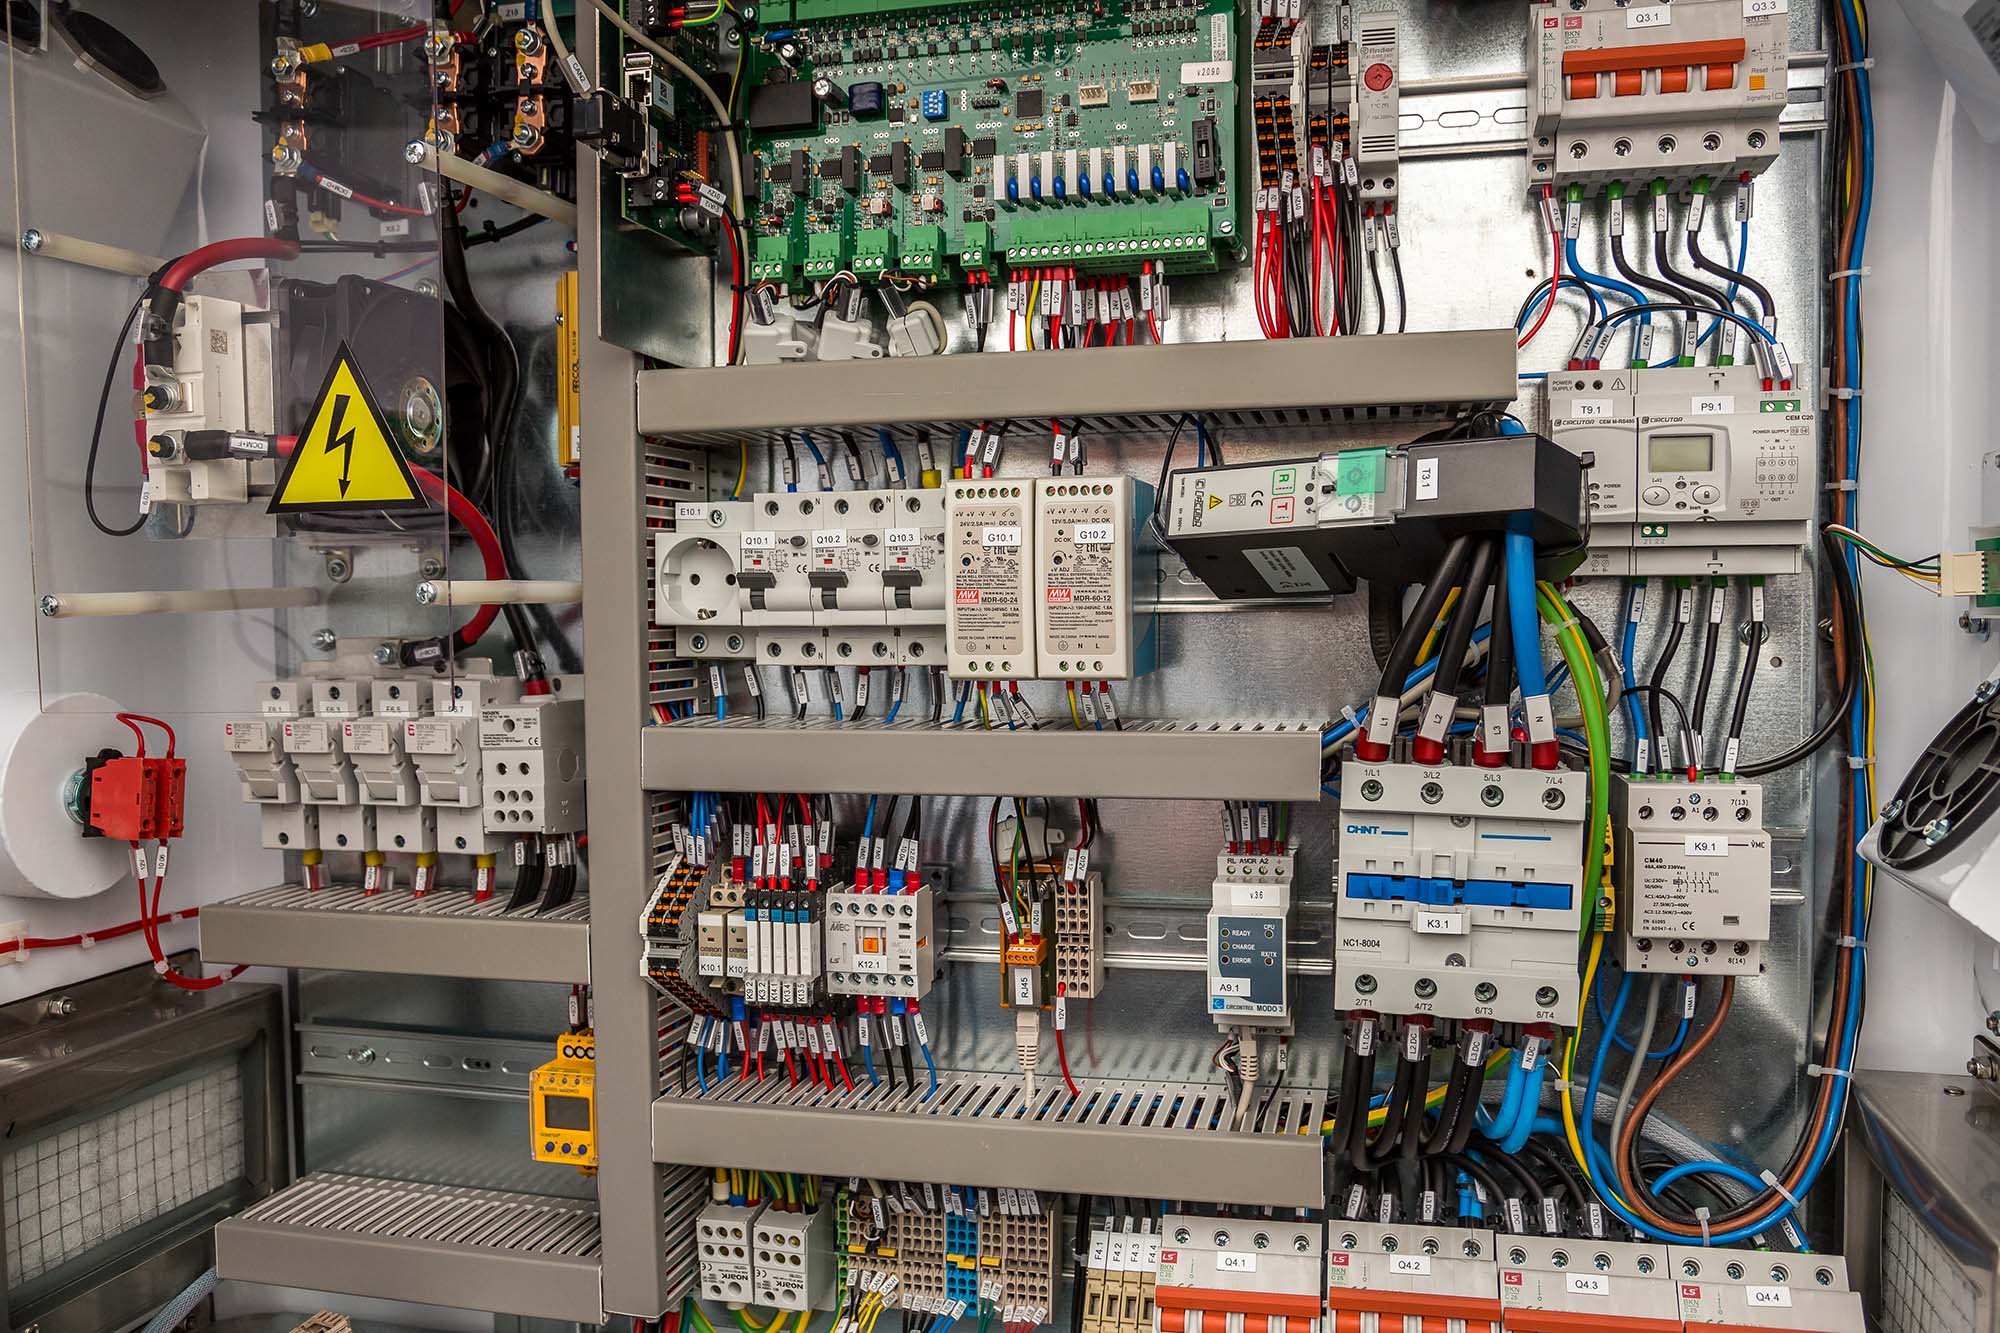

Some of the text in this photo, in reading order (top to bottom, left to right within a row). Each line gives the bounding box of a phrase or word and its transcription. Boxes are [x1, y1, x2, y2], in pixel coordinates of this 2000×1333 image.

[1752, 0, 1777, 12] Q3.3
[1635, 12, 1660, 24] Q3.1
[572, 63, 586, 82] CAN2
[1738, 198, 1747, 216] NM1
[1388, 223, 1397, 240] 12.07
[1582, 333, 1594, 349] FM1
[1598, 334, 1610, 350] NM1
[1688, 330, 1696, 347] L3.2
[1776, 352, 1787, 368] NM1
[1580, 406, 1601, 416] T9.1
[1700, 402, 1722, 412] P9.1
[1280, 474, 1290, 483] R
[1420, 467, 1432, 488] T3.1
[680, 507, 701, 516] E10.1
[1276, 502, 1288, 512] T
[816, 536, 840, 544] Q10.2
[889, 534, 914, 542] Q10.3
[988, 533, 1013, 542] G10.1
[1080, 530, 1107, 540] G10.2
[746, 537, 768, 546] Q10.1
[890, 652, 895, 660] N
[1380, 716, 1388, 726] L1
[1434, 714, 1443, 724] L2
[1536, 715, 1544, 723] N
[1494, 726, 1502, 736] L3
[1364, 769, 1380, 777] 1/L1
[1423, 770, 1441, 780] 3/L2
[1484, 773, 1502, 782] 5/L3
[1545, 776, 1563, 785] 7/L4
[1730, 798, 1749, 806] 7(13)
[1346, 824, 1380, 835] CHNT
[1694, 842, 1716, 852] K9.1
[899, 846, 908, 862] 10.04
[1426, 919, 1450, 928] K3.1
[1342, 938, 1380, 948] NC1-8004
[858, 960, 880, 969] K12.1
[1728, 957, 1746, 965] 8(14)
[700, 964, 722, 972] K10.1
[798, 984, 806, 1002] K13.5
[1020, 978, 1028, 998] RJ45
[1219, 984, 1240, 992] A9.1
[1355, 998, 1373, 1007] 2/T1
[1414, 1002, 1433, 1012] 4/T2
[1474, 1006, 1493, 1016] 6/T3
[1536, 1010, 1554, 1020] 8/T4
[873, 1204, 881, 1222] CAN2
[1113, 1242, 1122, 1262] F4.2
[1131, 1242, 1140, 1263] F4.3
[1224, 1258, 1246, 1268] Q4.1
[1332, 1255, 1346, 1263] LS
[1398, 1260, 1420, 1270] Q4.2
[1505, 1274, 1518, 1283] LS
[1575, 1280, 1598, 1290] Q4.3
[1683, 1288, 1697, 1296] LS
[1756, 1292, 1780, 1302] Q4.4
